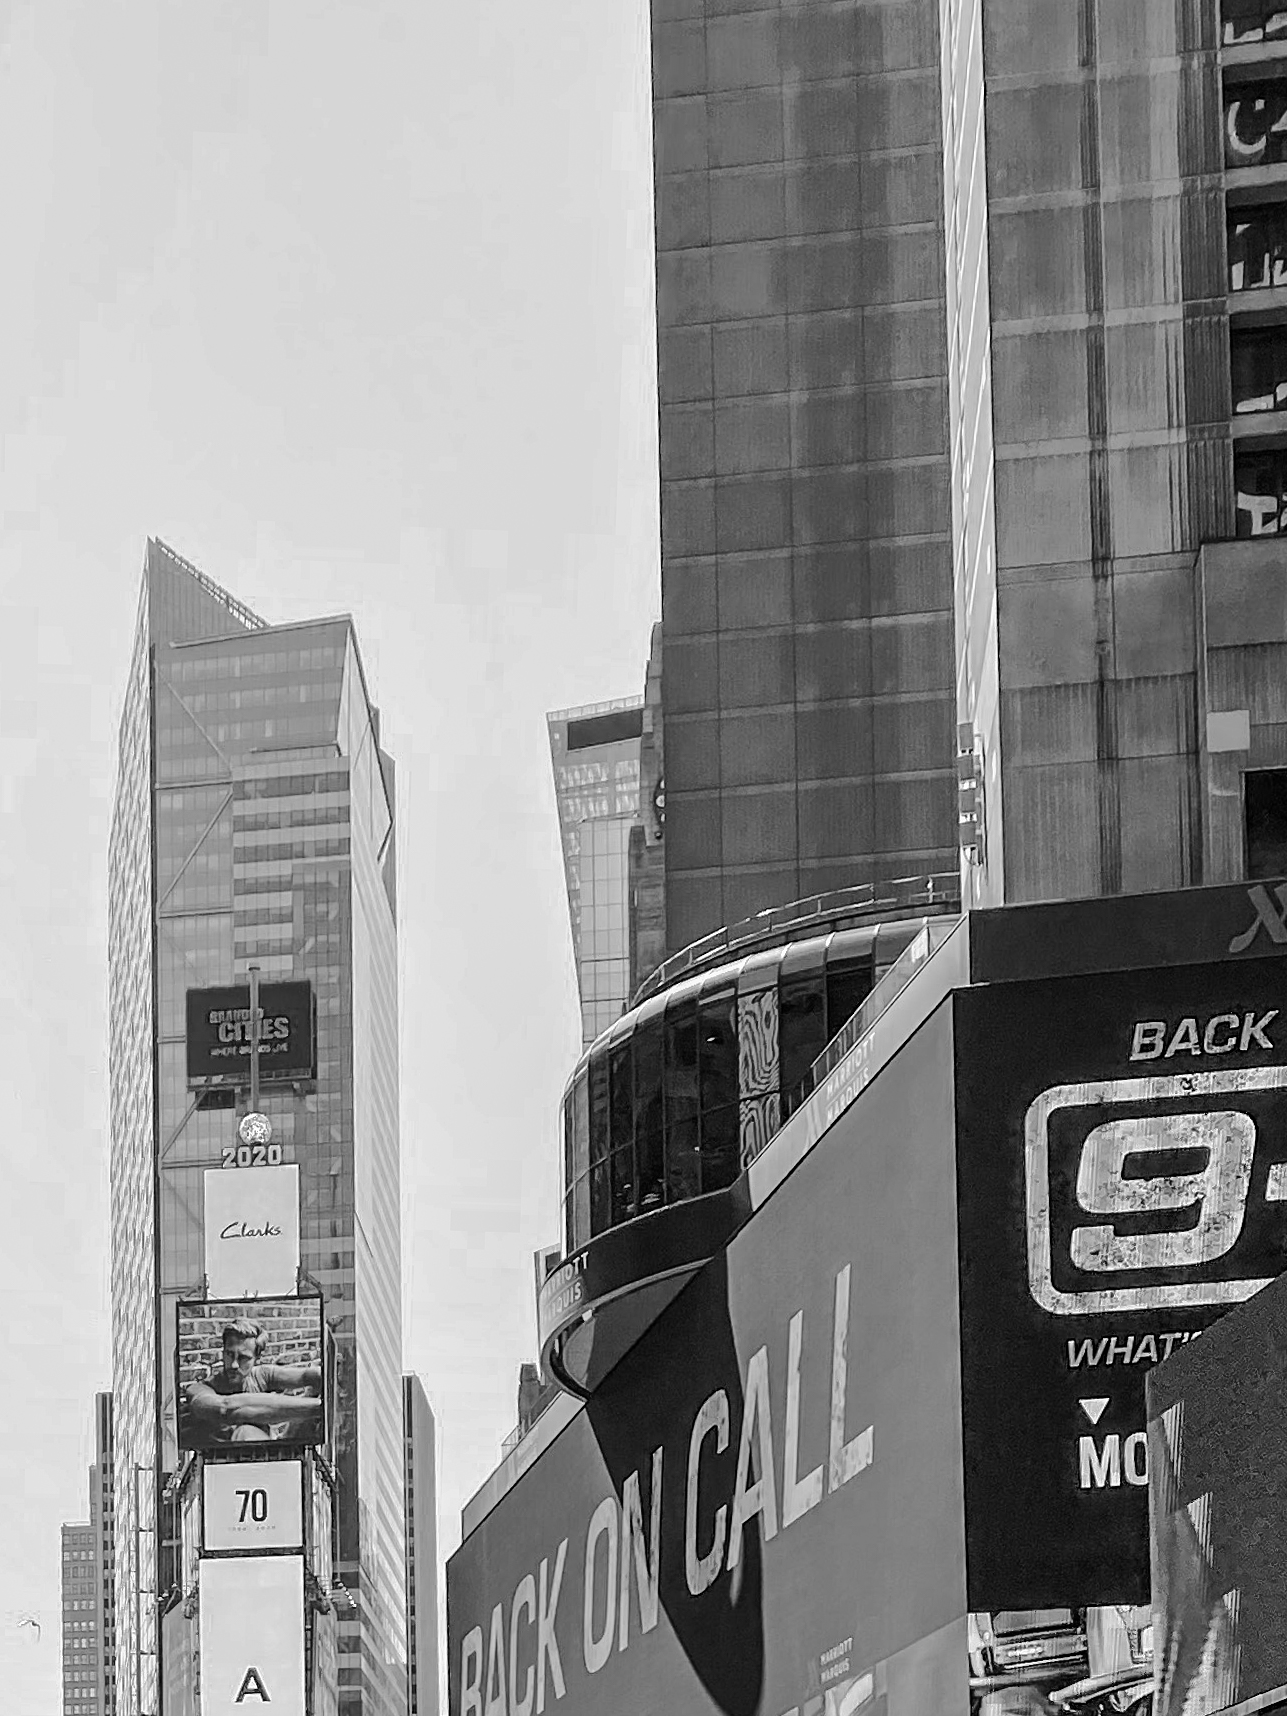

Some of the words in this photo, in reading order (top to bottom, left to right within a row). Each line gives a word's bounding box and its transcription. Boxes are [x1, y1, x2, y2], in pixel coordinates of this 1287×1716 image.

[219, 1017, 289, 1042] CITIES
[1129, 1010, 1278, 1062] BACK
[222, 1144, 282, 1168] 2020
[220, 1222, 281, 1239] Clarks
[583, 1446, 663, 1673] ON
[684, 1263, 875, 1596] CALL
[235, 1488, 268, 1522] 70
